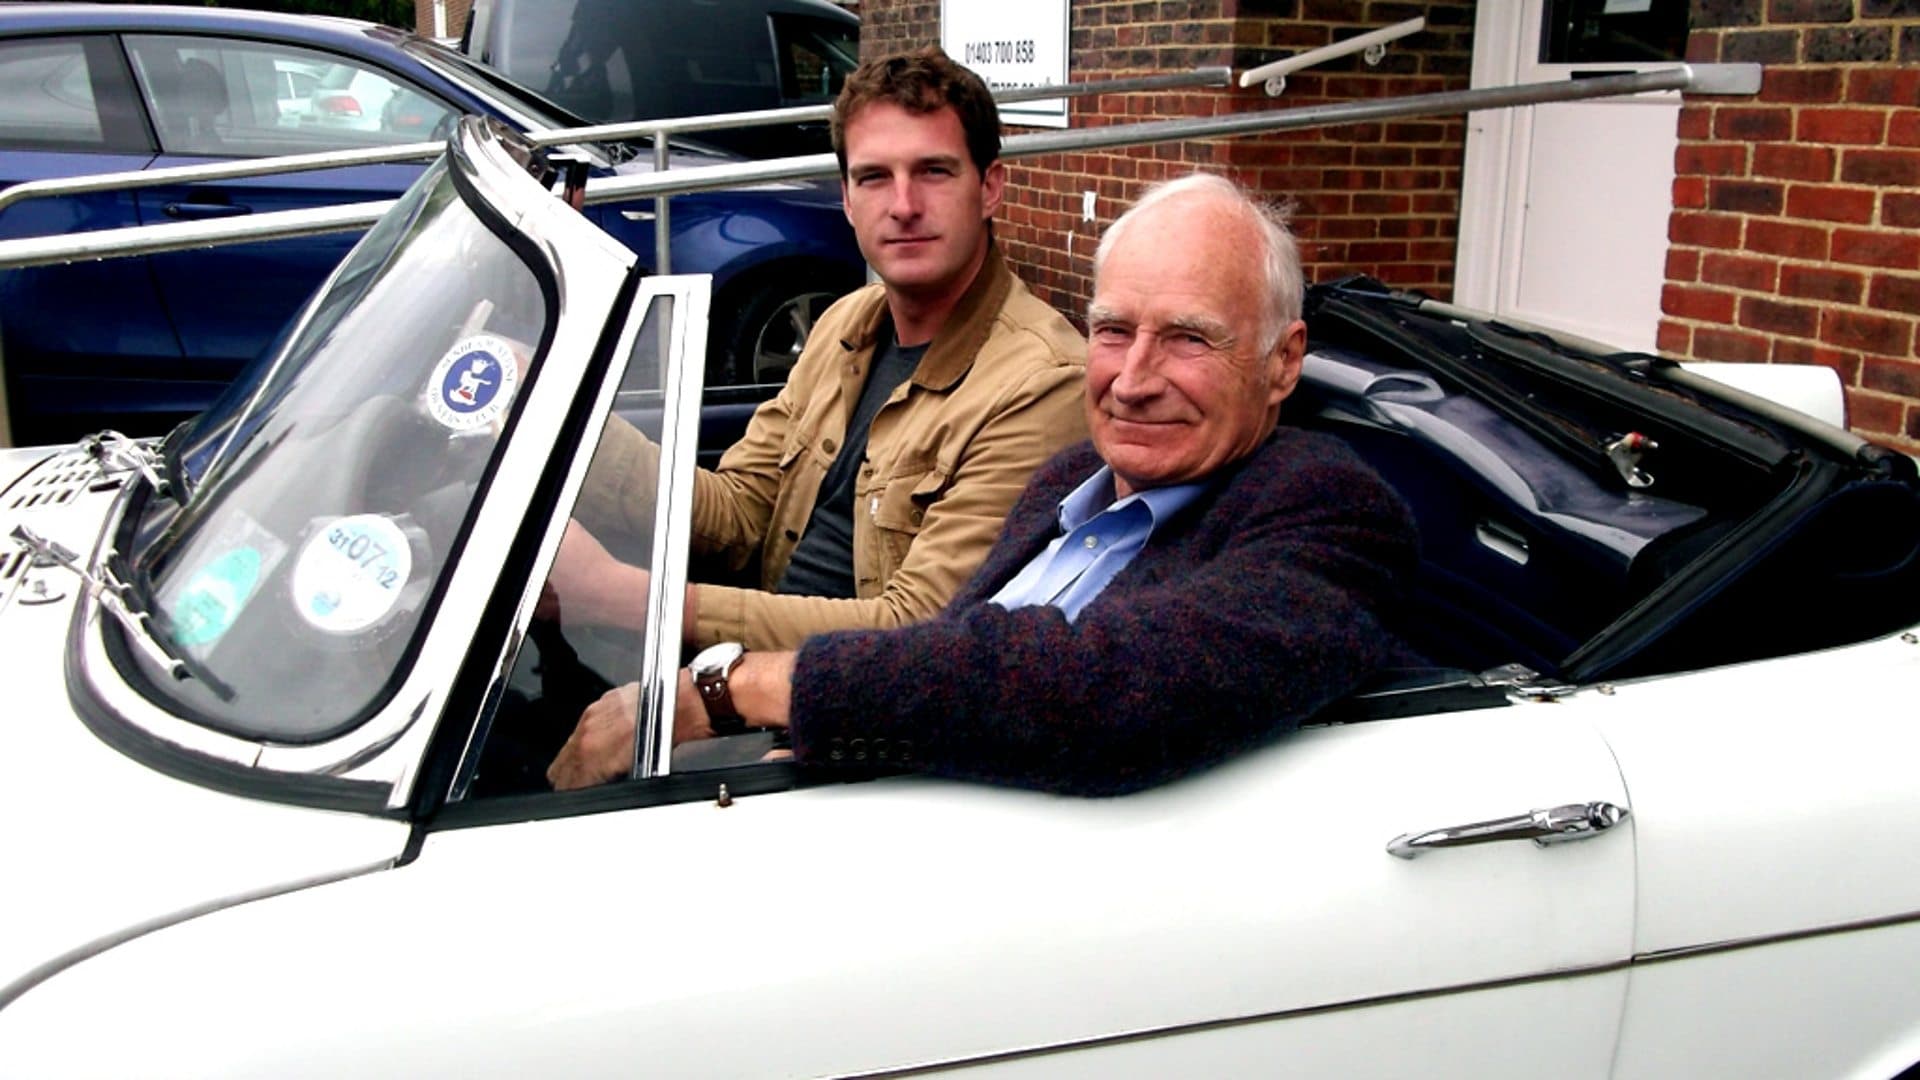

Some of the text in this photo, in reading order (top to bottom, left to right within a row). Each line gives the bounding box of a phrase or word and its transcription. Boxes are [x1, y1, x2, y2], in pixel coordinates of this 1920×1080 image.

[965, 39, 1035, 64] 01403 700 858
